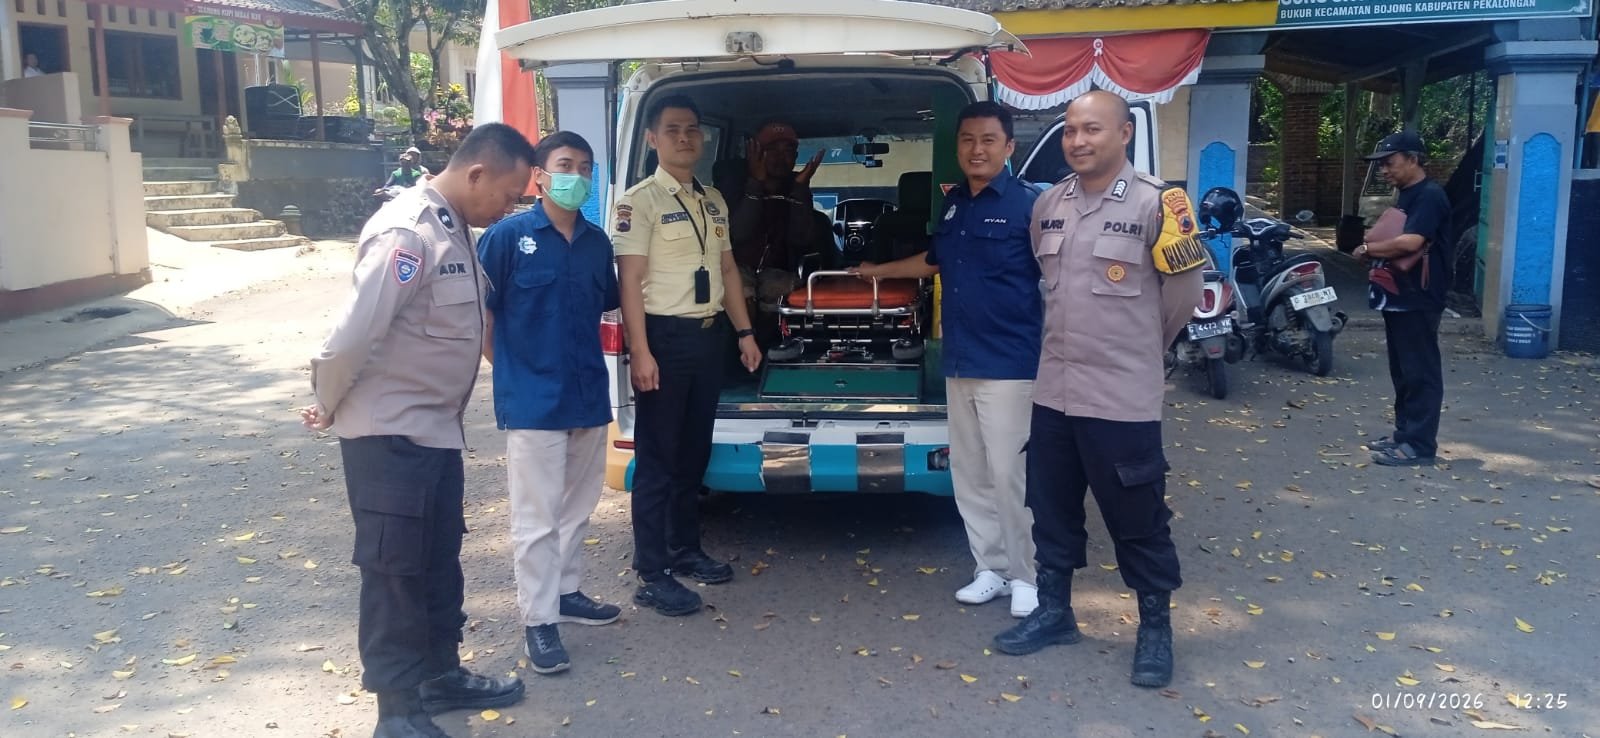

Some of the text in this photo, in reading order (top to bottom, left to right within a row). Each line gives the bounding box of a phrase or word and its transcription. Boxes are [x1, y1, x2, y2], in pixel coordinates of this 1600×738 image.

[1280, 0, 1536, 18] BUKUR KECAMATAN BOJONG KABUPATEN PEKALONGAN
[1103, 220, 1143, 236] POLRI
